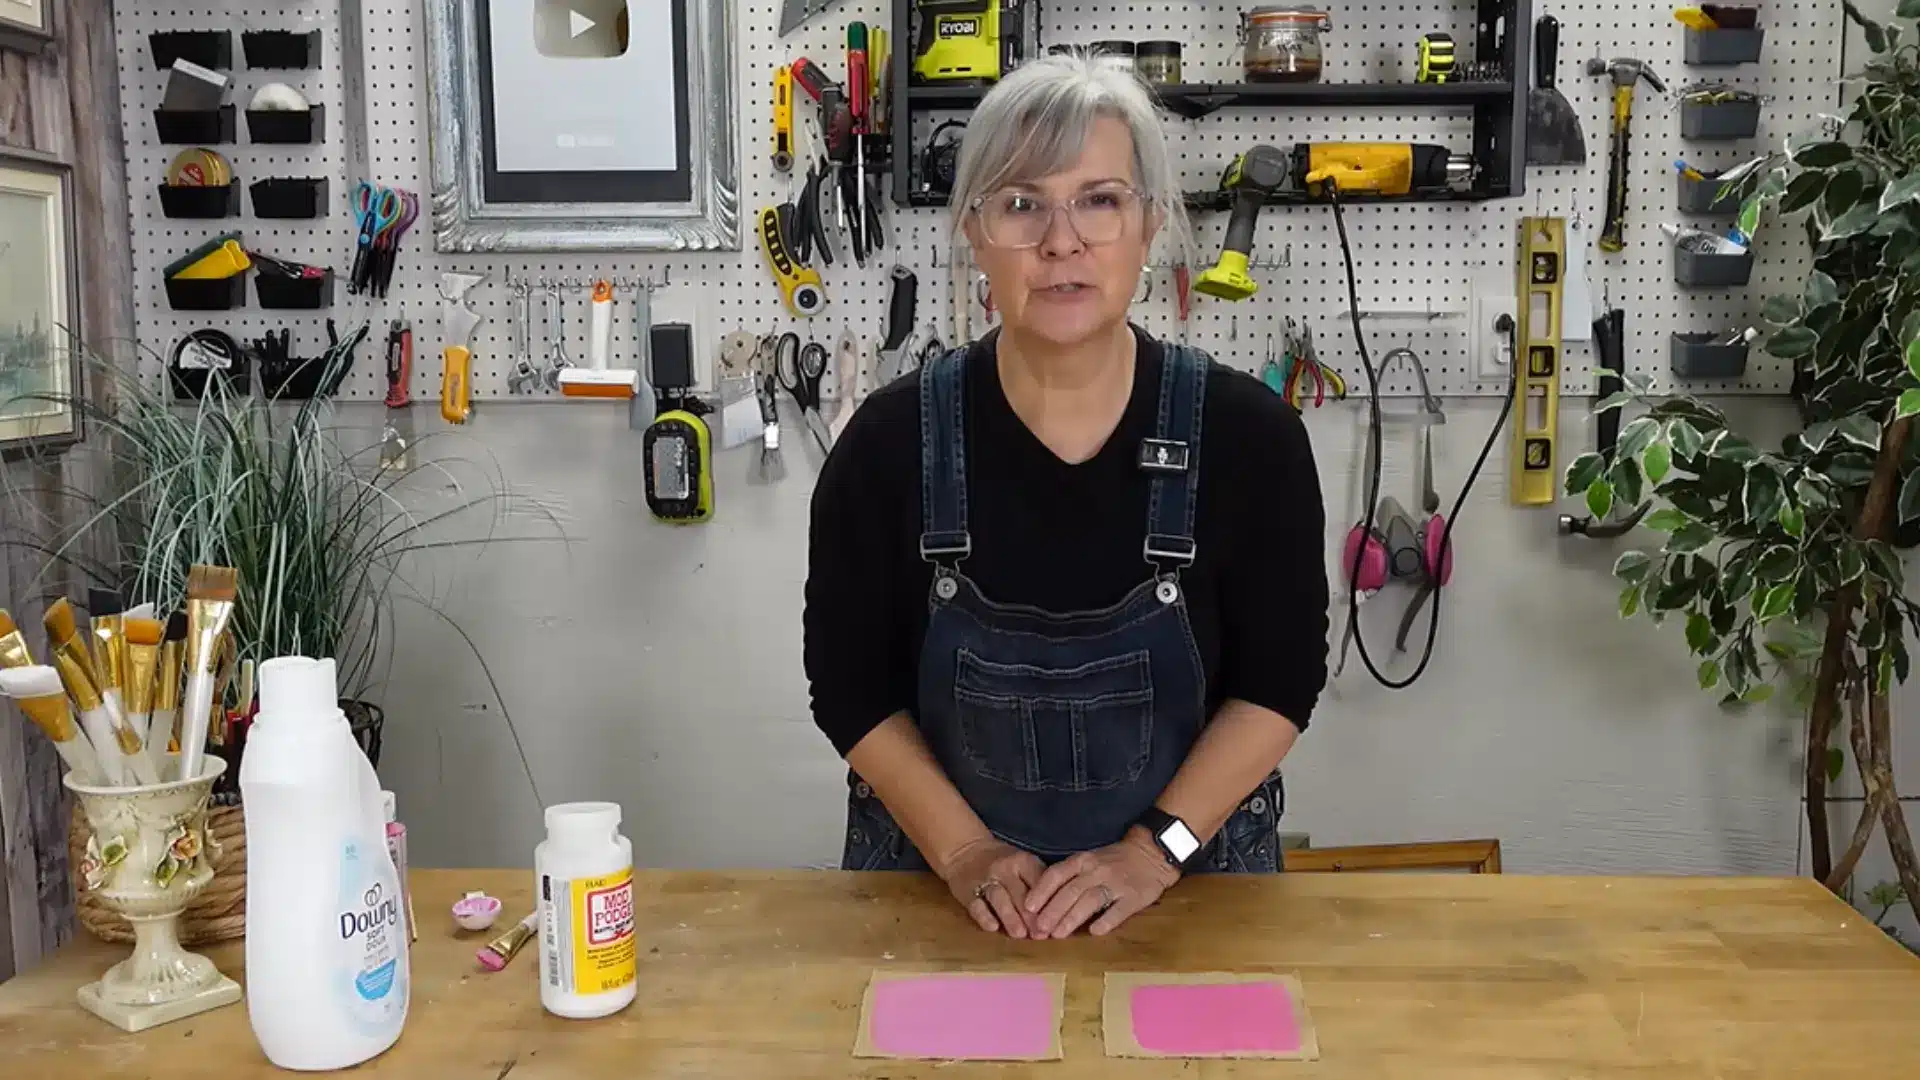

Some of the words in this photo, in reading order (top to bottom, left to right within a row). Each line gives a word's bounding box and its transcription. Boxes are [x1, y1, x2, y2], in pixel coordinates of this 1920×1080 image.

[941, 22, 974, 34] RYOBI
[603, 889, 629, 910] MOD
[341, 897, 397, 939] Downy
[595, 902, 633, 926] PODGE
[366, 925, 385, 941] SOFT
